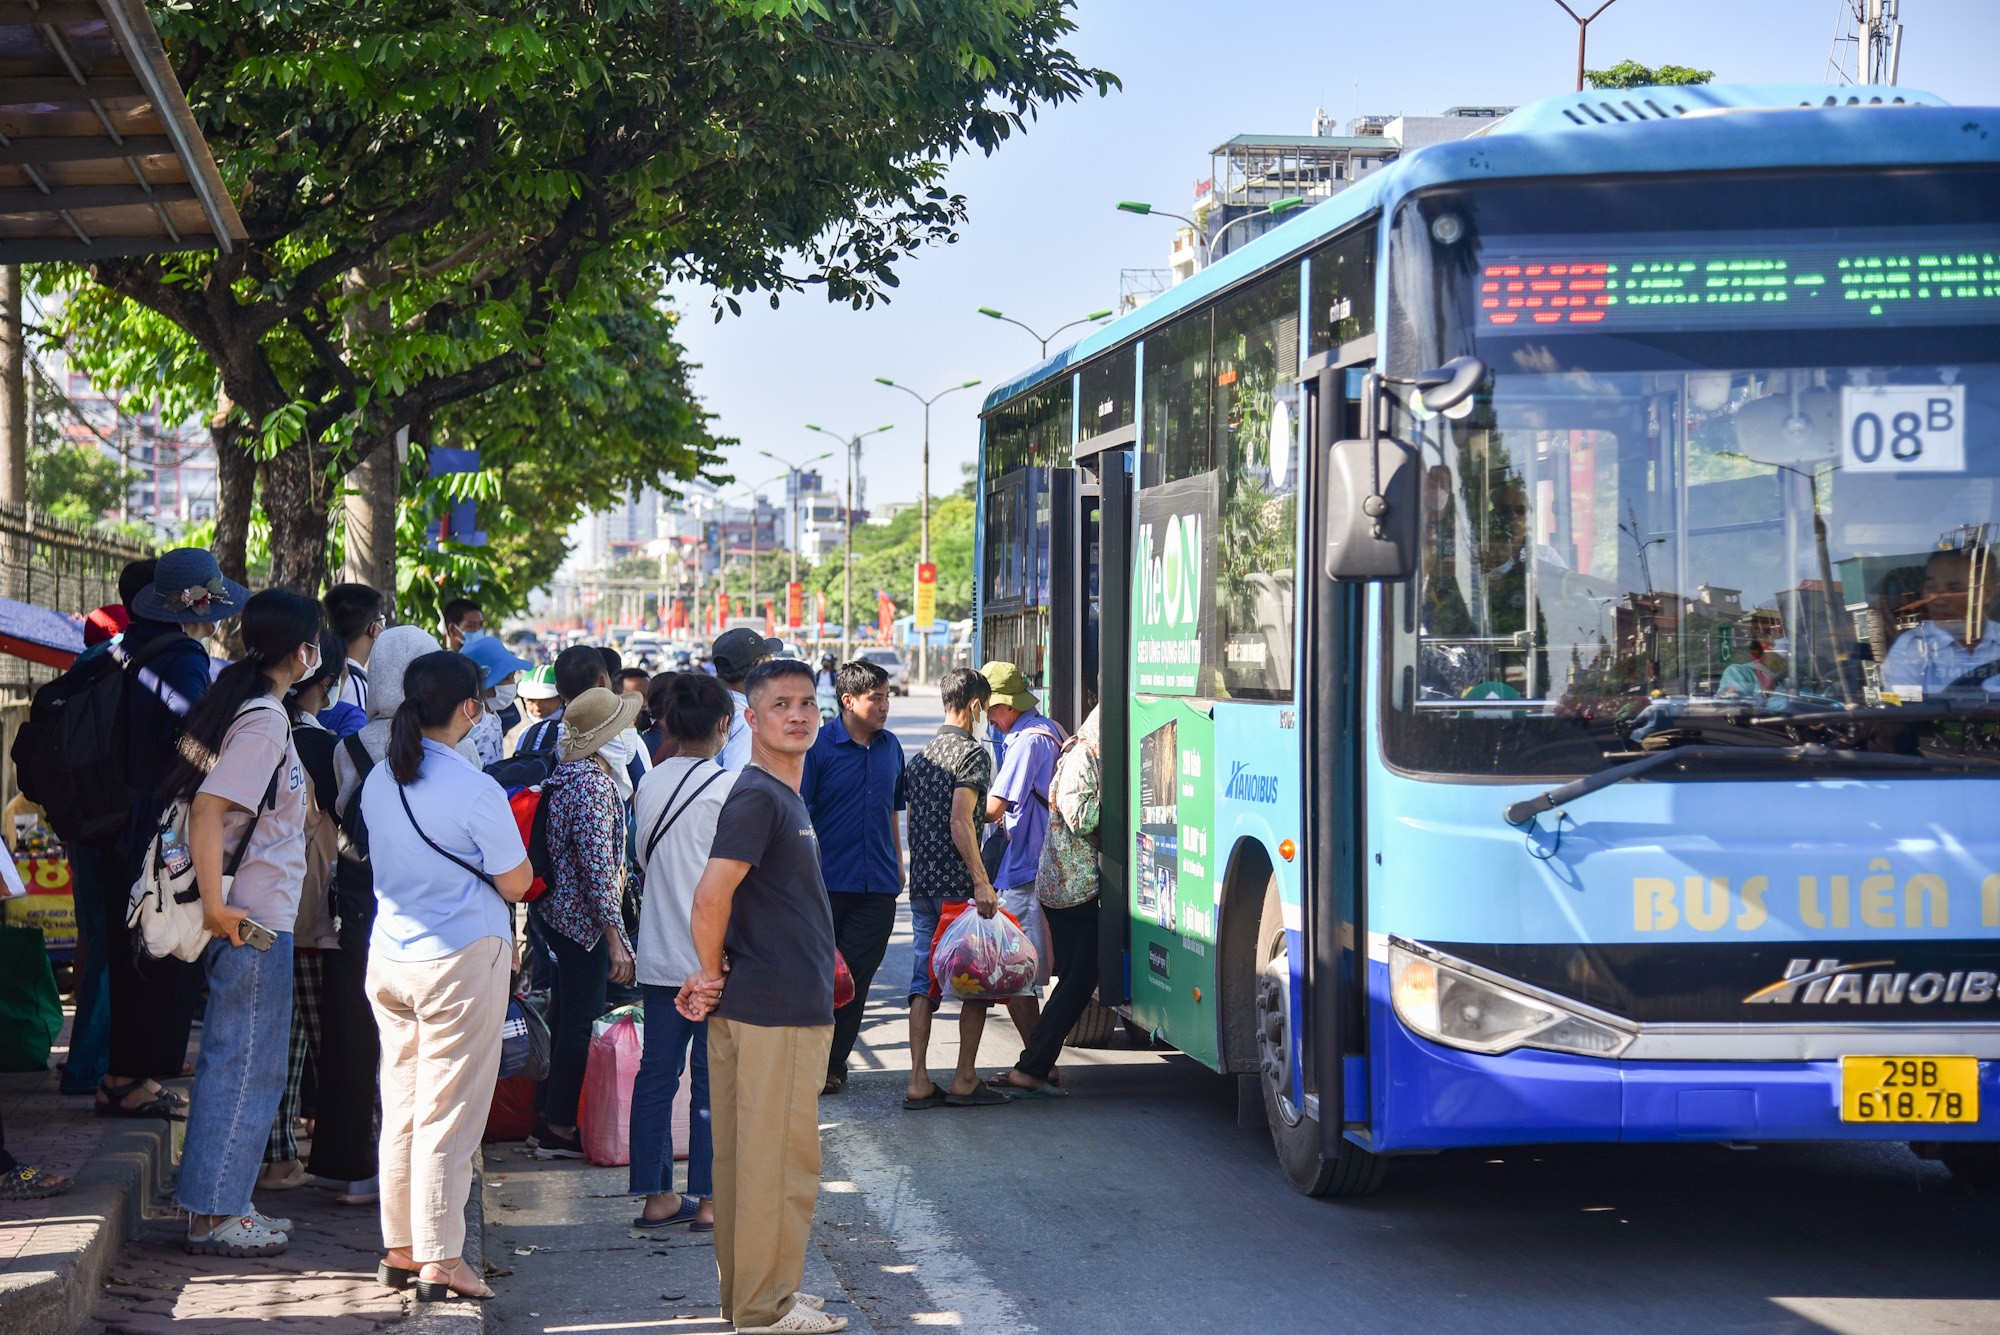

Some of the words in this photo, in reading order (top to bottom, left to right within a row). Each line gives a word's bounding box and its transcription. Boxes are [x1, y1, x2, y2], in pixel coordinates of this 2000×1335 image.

[1139, 513, 1202, 628] VieON
[1224, 760, 1279, 804] HANOIBUS
[1633, 876, 1769, 931] BUS
[1800, 857, 1949, 929] LIÊN
[1743, 958, 2000, 1004] HANOIB
[1882, 1060, 1938, 1087] 29B
[1858, 1092, 1963, 1119] 618.78
